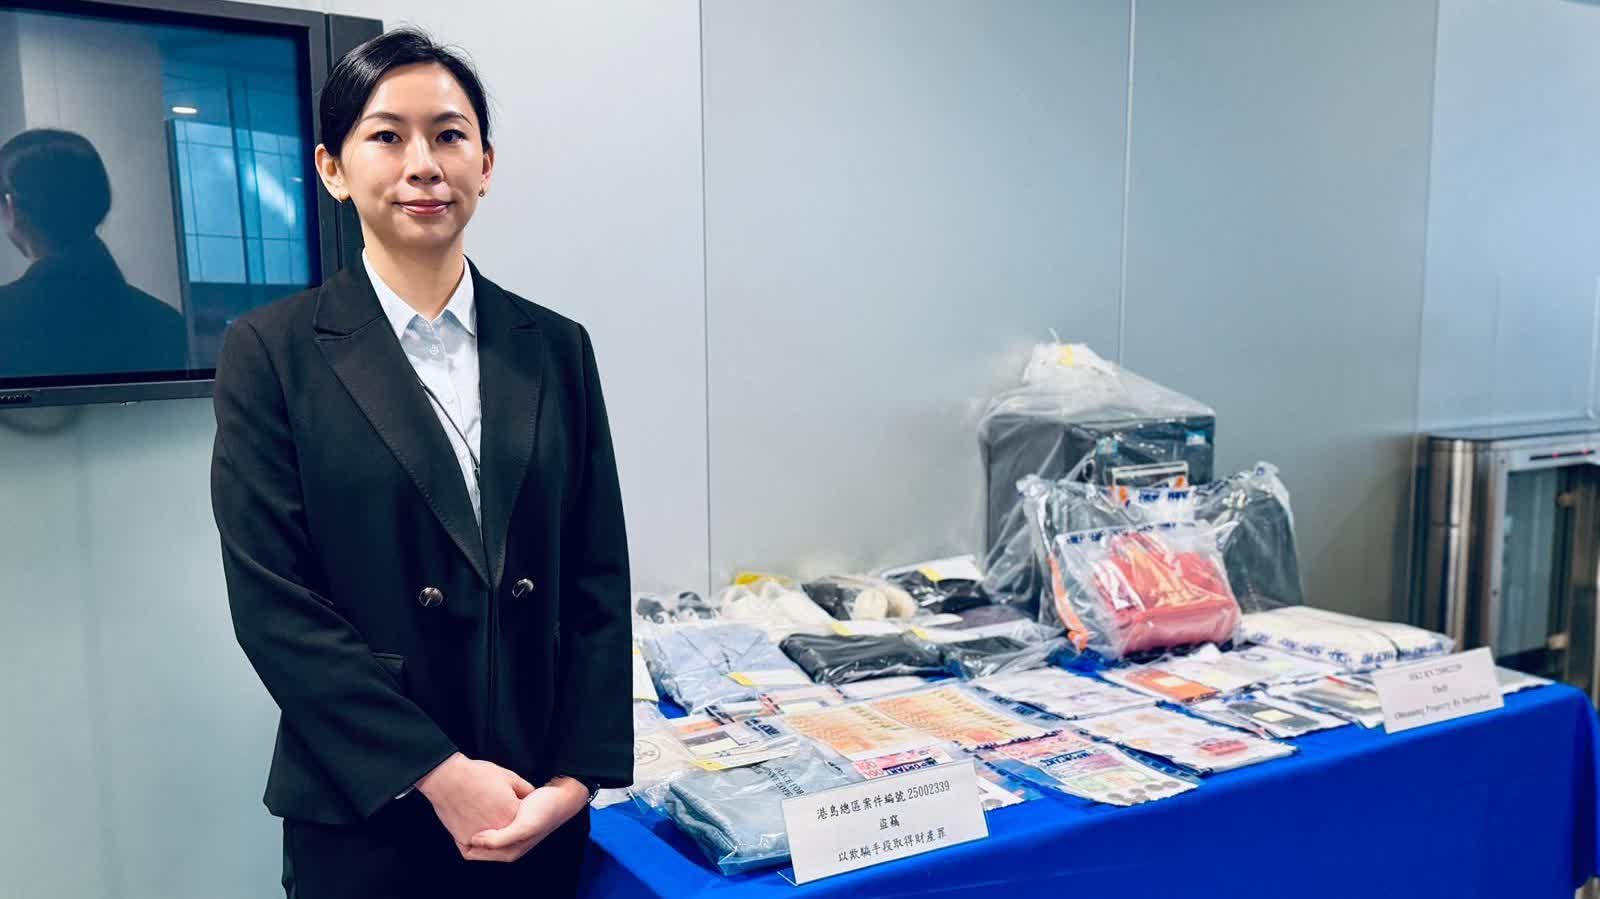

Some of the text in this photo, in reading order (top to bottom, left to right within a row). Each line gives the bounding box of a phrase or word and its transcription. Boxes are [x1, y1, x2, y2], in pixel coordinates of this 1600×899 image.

[817, 780, 950, 820] 港島總區案件編號 25002339
[838, 826, 947, 862] 以欺騙手段取得財產罪
